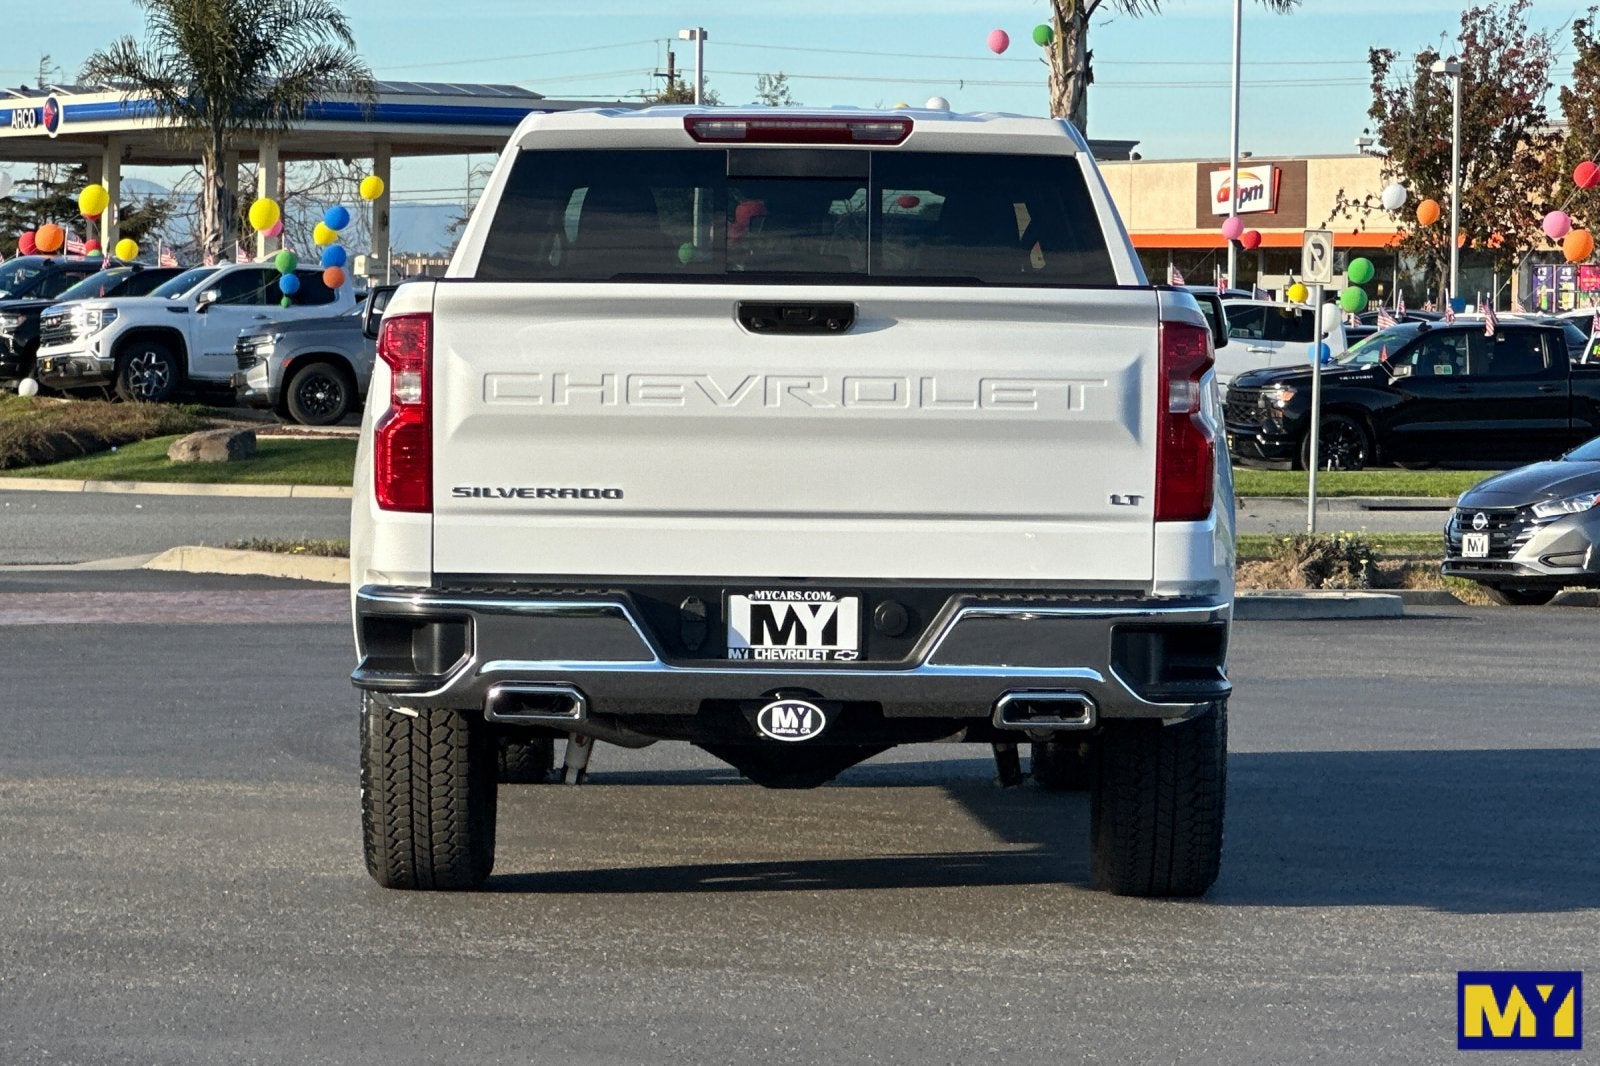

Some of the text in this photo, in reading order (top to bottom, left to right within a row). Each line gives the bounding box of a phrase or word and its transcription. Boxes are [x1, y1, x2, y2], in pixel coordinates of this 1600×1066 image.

[11, 108, 36, 128] ARCO
[1217, 184, 1264, 209] apm
[483, 372, 1107, 411] CHEVROLET
[452, 487, 624, 499] SILVERADO
[1110, 494, 1144, 506] LT
[754, 590, 830, 601] MYCARS.COM
[750, 603, 838, 646] MY
[728, 648, 829, 660] MY CHEVROLET
[771, 707, 812, 728] MY
